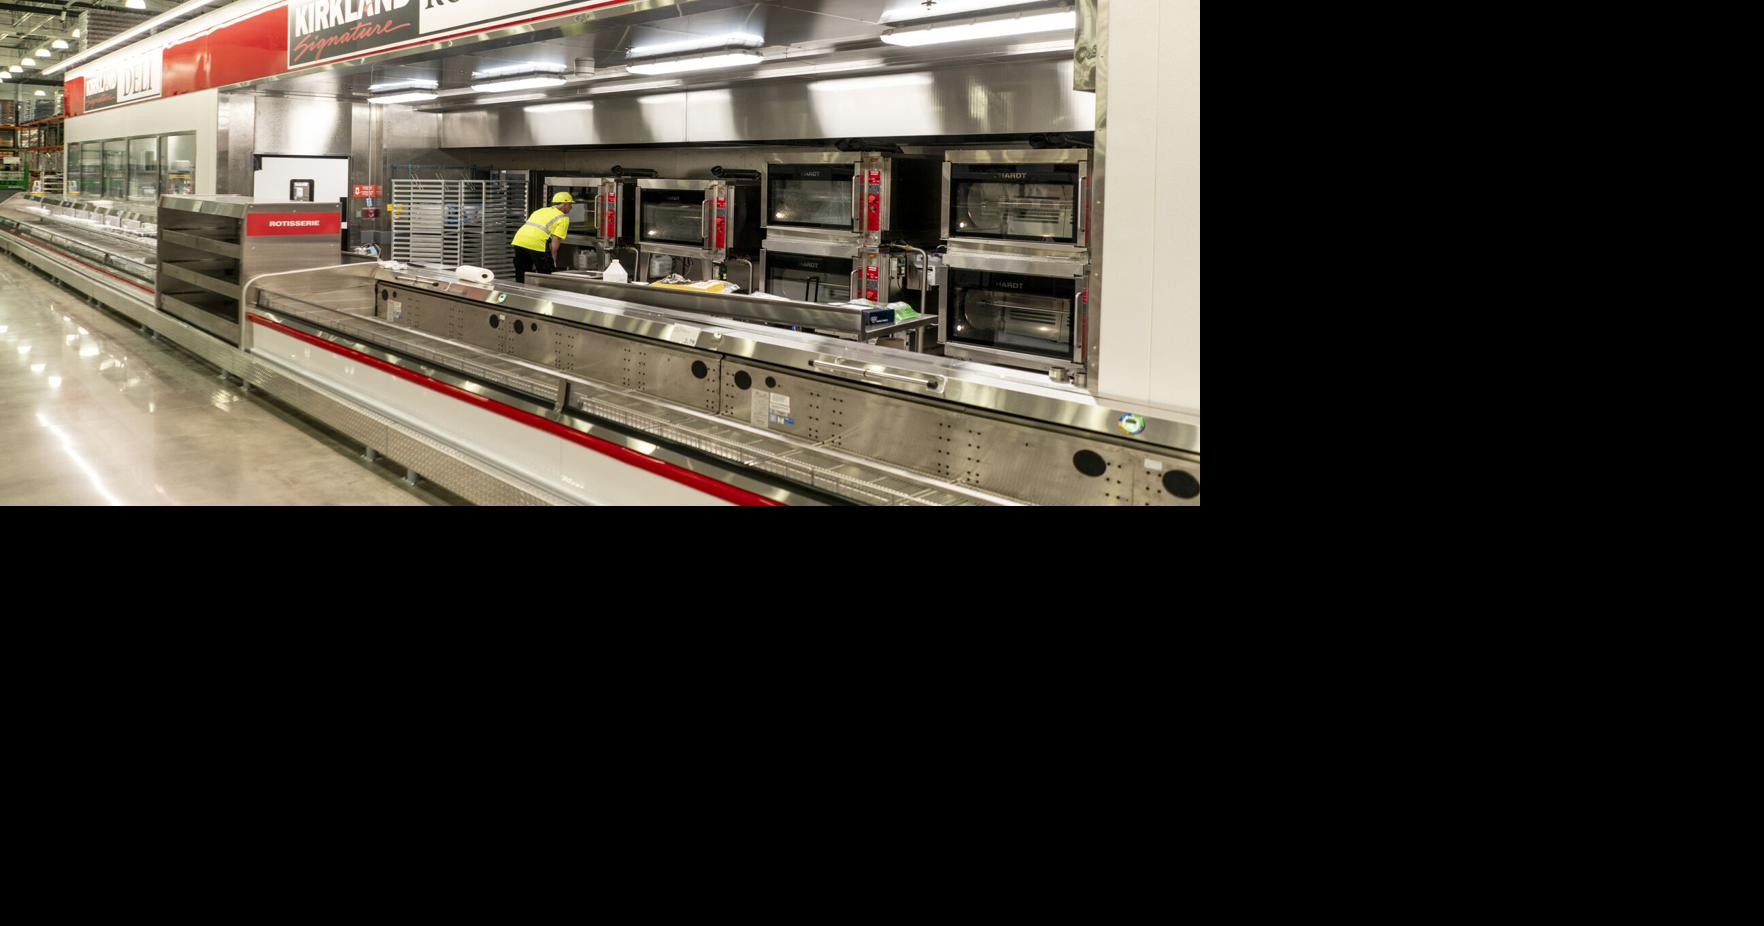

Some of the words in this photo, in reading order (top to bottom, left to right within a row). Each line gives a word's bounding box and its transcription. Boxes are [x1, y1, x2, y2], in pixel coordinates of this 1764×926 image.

[295, 0, 408, 37] KIRKLA
[294, 20, 411, 61] Signature
[122, 59, 152, 96] DELI
[269, 219, 320, 228] ROTISSERIE
